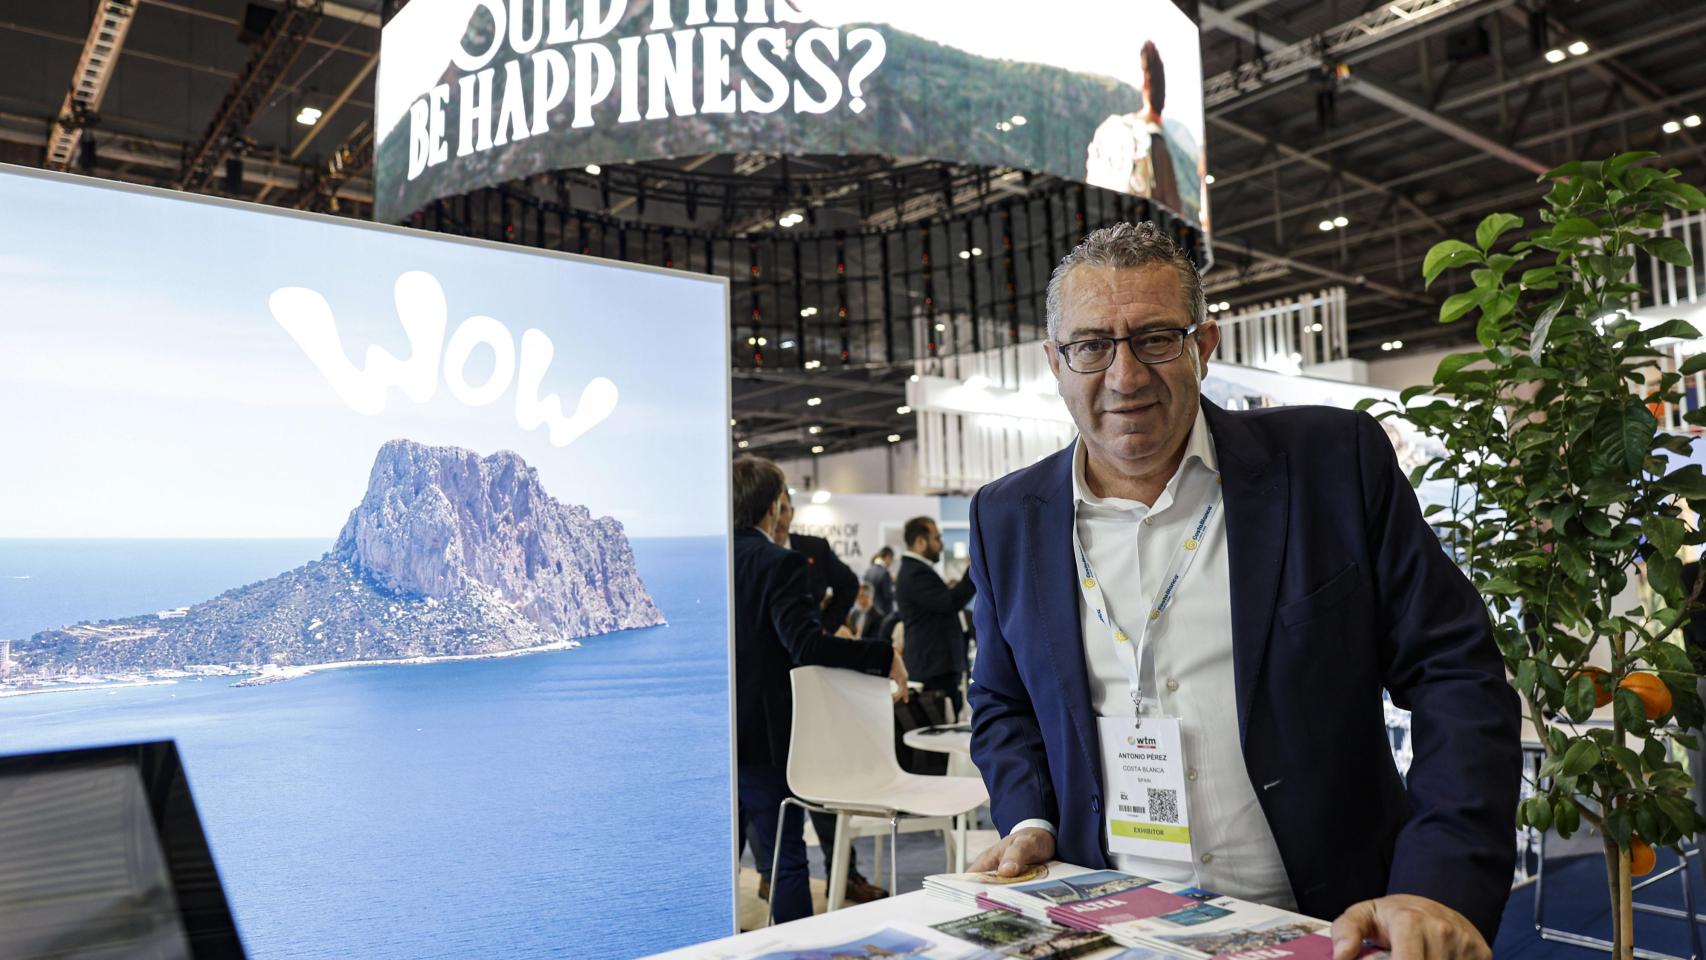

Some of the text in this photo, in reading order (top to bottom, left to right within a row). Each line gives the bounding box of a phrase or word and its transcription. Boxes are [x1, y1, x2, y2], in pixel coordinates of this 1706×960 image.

[449, 0, 628, 71] OULD
[407, 27, 887, 181] BE HAPPINESS?
[269, 270, 619, 448] WOW
[844, 523, 859, 537] OF
[833, 540, 862, 557] CIA
[1137, 736, 1156, 745] wtm
[1118, 752, 1167, 761] ANTONIO PÉREZ
[1142, 766, 1165, 774] BLANCA
[1133, 827, 1165, 836] EXHIBITOR
[1070, 899, 1128, 913] ALTEA
